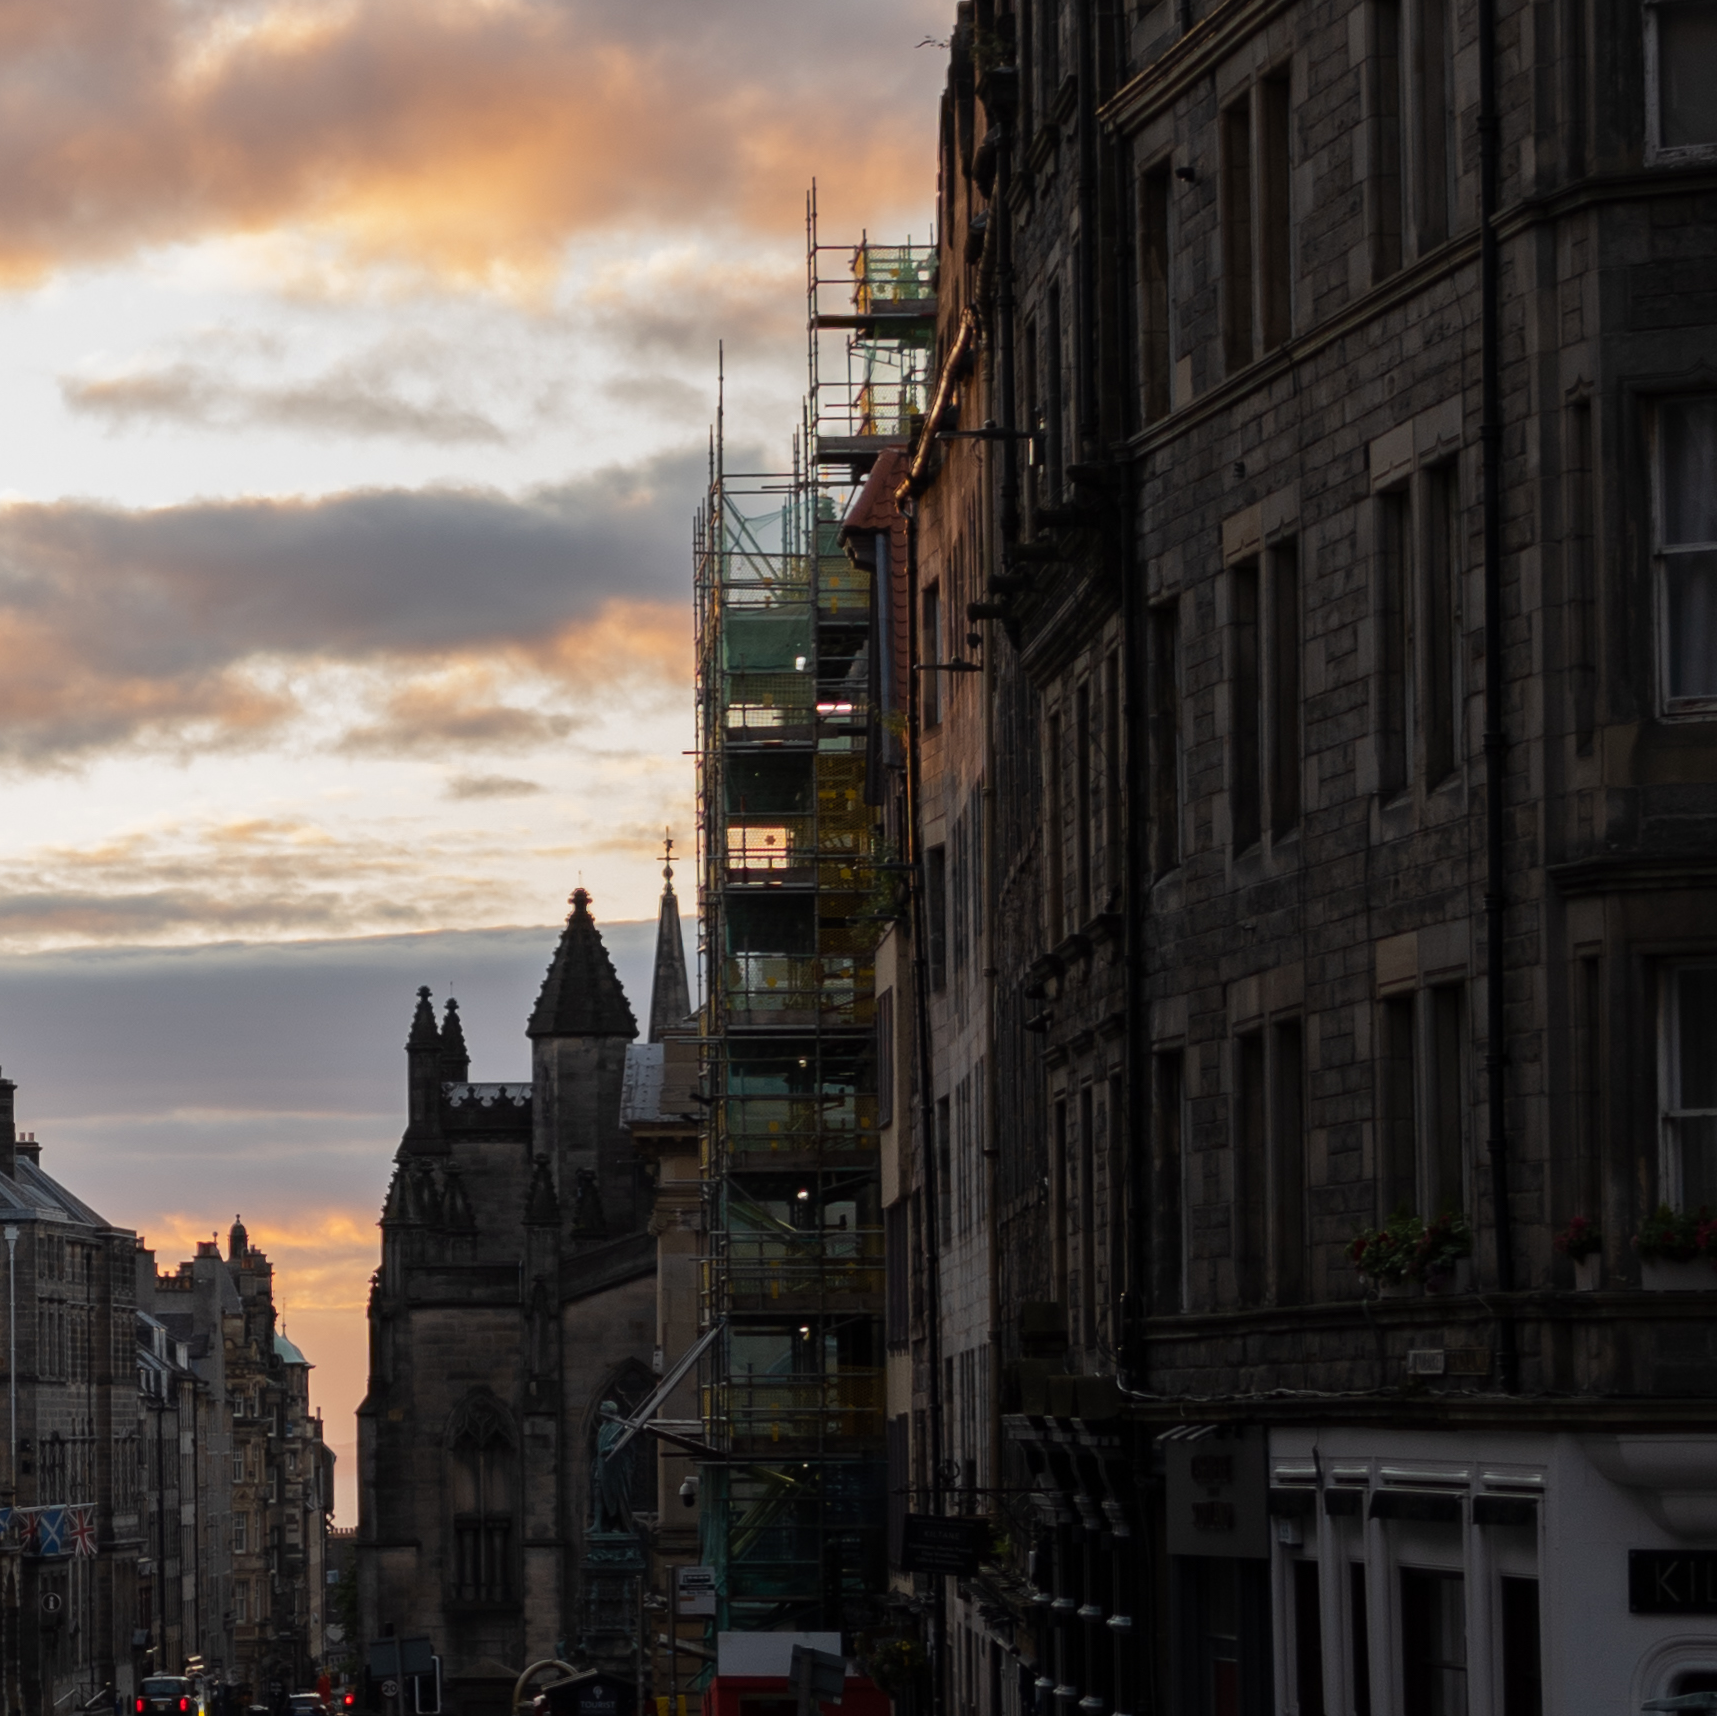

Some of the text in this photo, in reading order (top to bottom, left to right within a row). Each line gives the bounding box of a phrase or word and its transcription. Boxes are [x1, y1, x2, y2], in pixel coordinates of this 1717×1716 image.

[924, 1530, 960, 1540] KILTANE
[382, 1684, 397, 1693] 20
[580, 1701, 615, 1709] TOURIST
